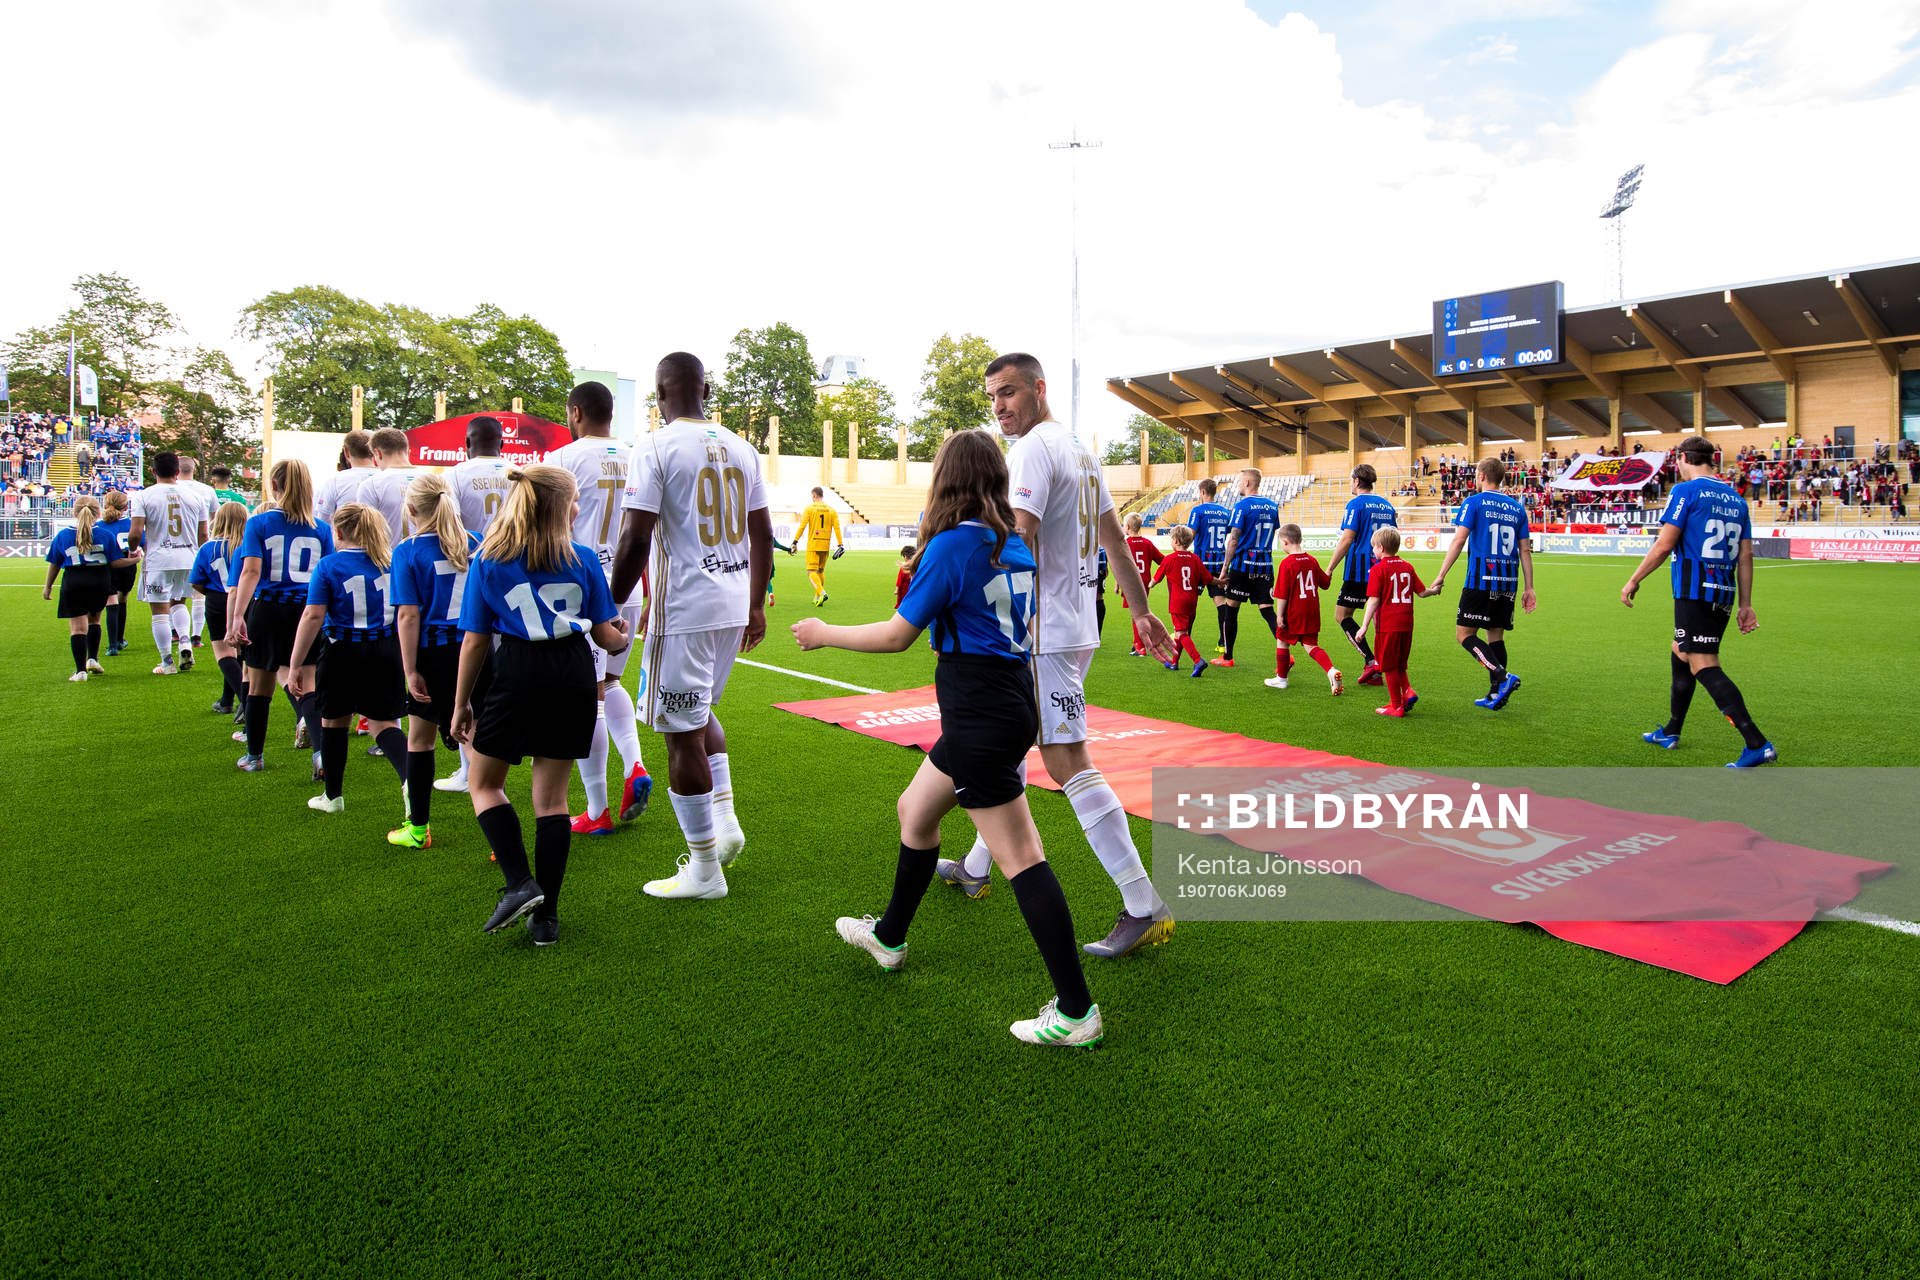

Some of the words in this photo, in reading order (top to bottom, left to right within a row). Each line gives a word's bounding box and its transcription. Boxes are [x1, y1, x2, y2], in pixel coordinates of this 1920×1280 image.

[1459, 360, 1467, 371] 0
[1477, 358, 1484, 369] 0
[1518, 349, 1552, 364] 00:00
[420, 446, 467, 461] Framå
[697, 467, 747, 547] 90
[168, 503, 182, 537] 5
[819, 514, 824, 528] 1
[1208, 526, 1226, 549] 15
[1255, 523, 1274, 548] 17
[1489, 523, 1516, 556] 19
[1543, 537, 1573, 549] gibon
[1579, 537, 1611, 550] gibon
[1617, 538, 1650, 552] gibon
[1701, 519, 1743, 560] 23
[1810, 541, 1858, 550] VAKSALA
[1860, 541, 1905, 551] MÅLERI
[264, 534, 322, 583] 10
[434, 560, 469, 620] 7
[1181, 566, 1193, 591] 8
[1297, 569, 1316, 599] 14
[1390, 572, 1411, 604] 12
[343, 573, 394, 628] 11
[504, 582, 592, 641] 18
[983, 571, 1034, 652] 17
[657, 685, 700, 706] Sports
[665, 700, 698, 714] gym
[1490, 850, 1626, 900] SVENSKA
[1603, 832, 1678, 855] SPEL
